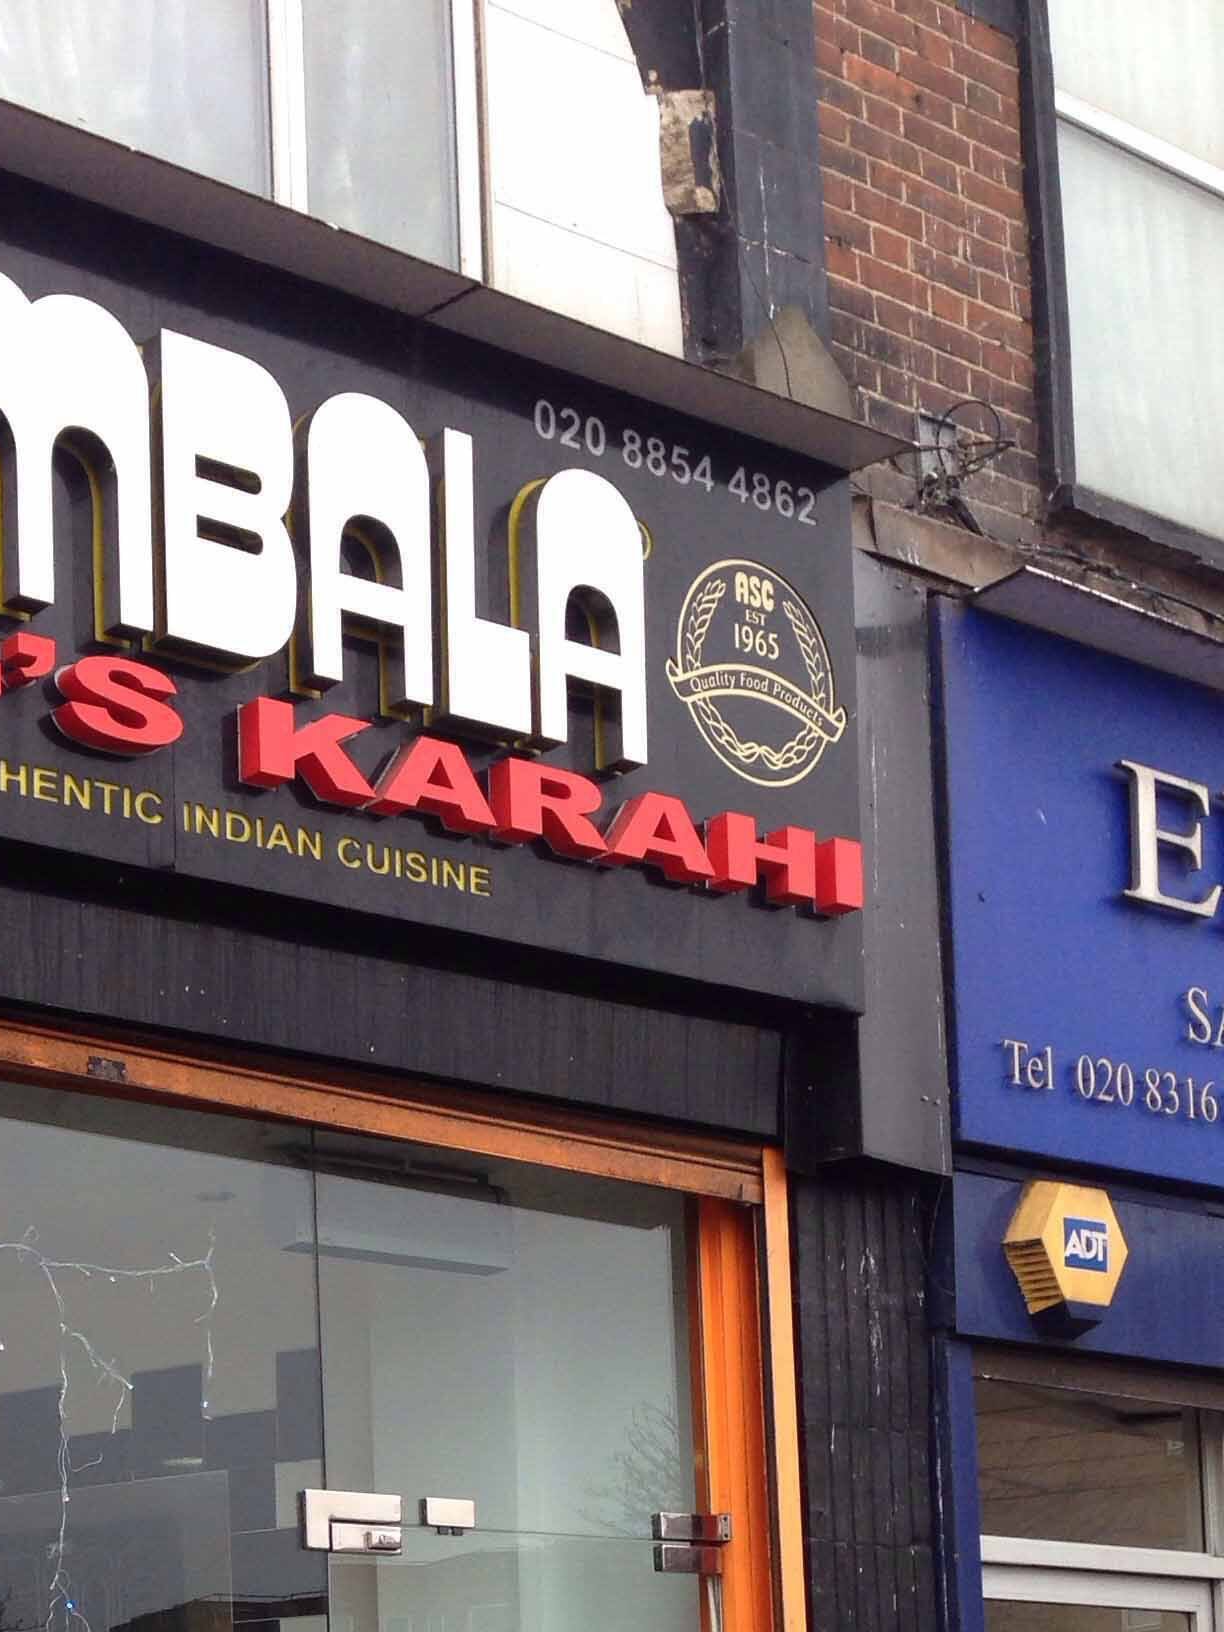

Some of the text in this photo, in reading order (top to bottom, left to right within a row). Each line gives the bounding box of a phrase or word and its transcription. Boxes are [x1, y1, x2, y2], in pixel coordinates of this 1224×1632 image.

[534, 399, 817, 526] 020 8854 4862
[734, 570, 775, 613] ASC
[745, 608, 767, 627] EST
[734, 623, 780, 660] 1965
[690, 672, 825, 727] Quality Food Products
[238, 696, 864, 916] KARAHI
[183, 802, 322, 861] INDIAN
[336, 838, 493, 898] CUISINE
[1000, 1039, 1218, 1123] Tel 020 8316
[1064, 1228, 1108, 1262] ADT
